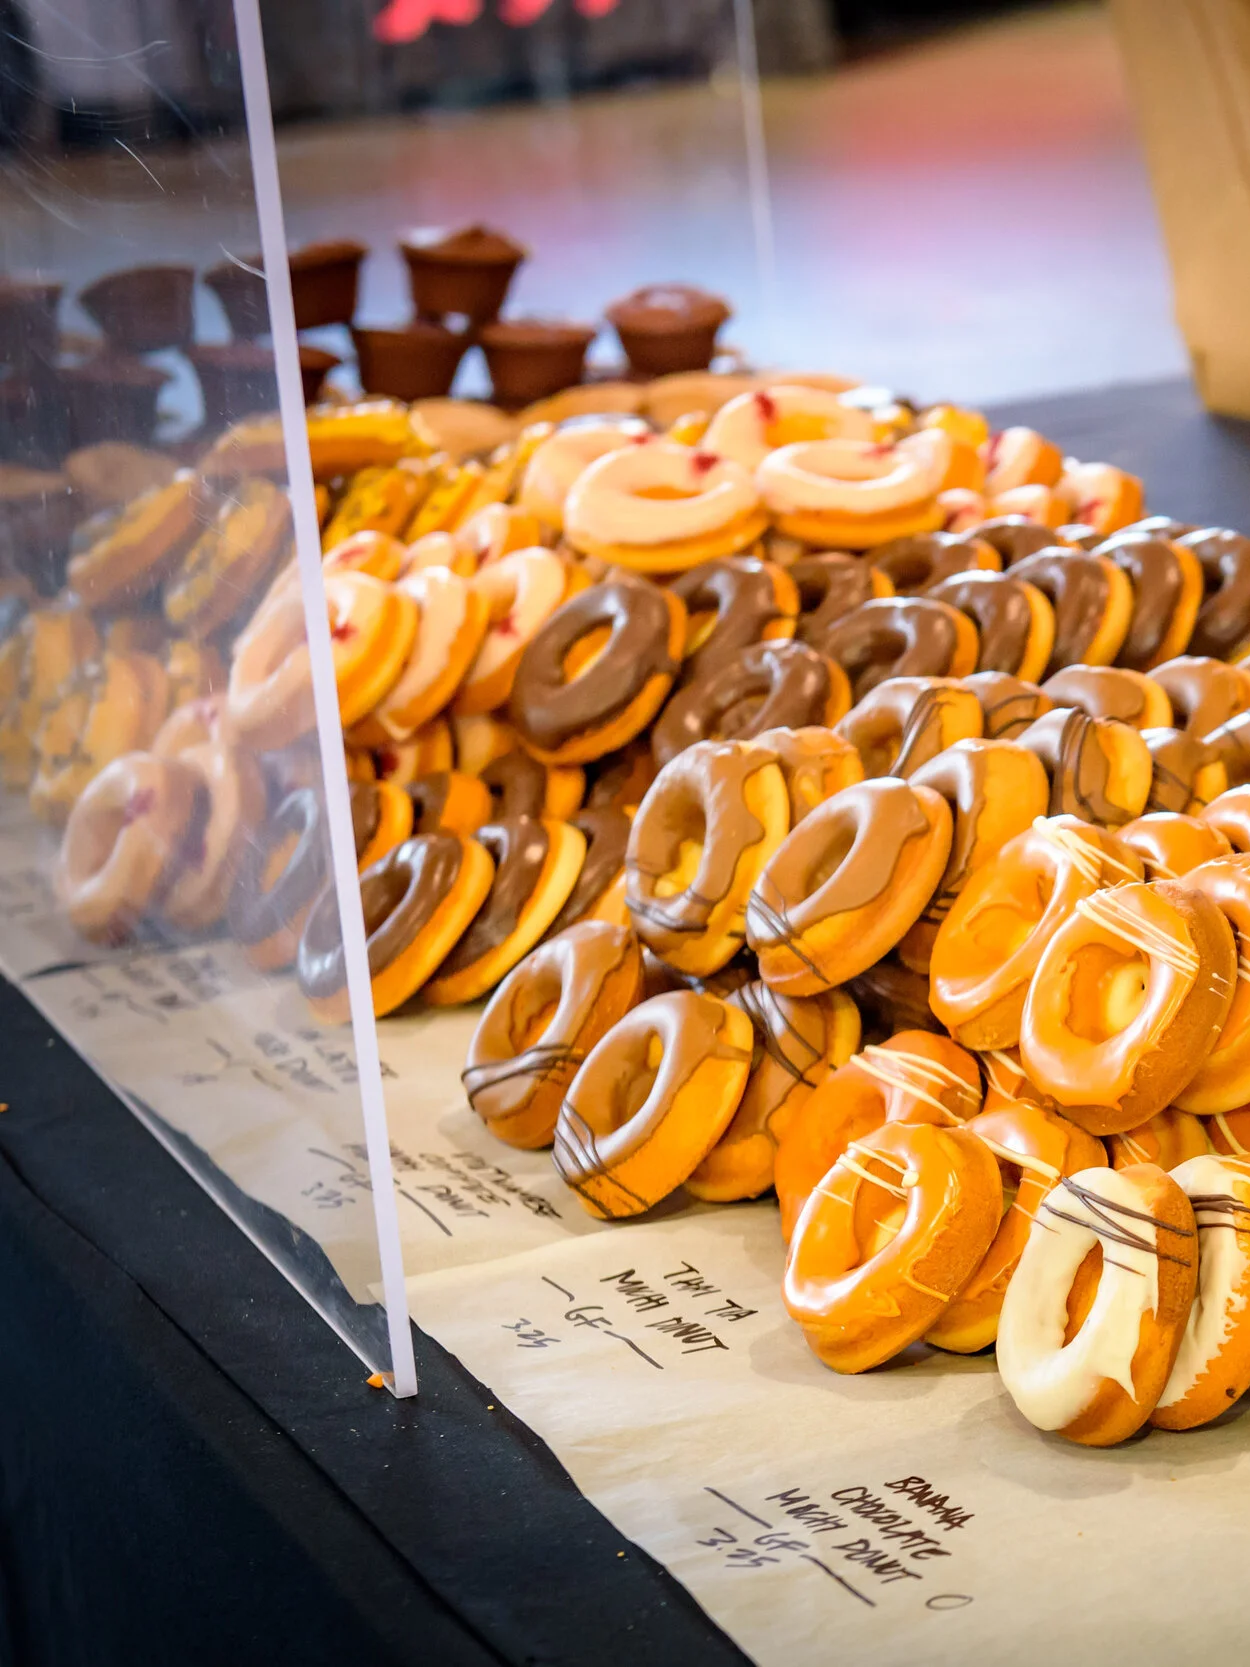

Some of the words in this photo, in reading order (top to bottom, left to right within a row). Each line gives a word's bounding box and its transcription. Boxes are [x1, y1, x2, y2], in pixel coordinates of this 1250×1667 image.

[765, 1488, 848, 1534] MOCHI
[831, 1539, 923, 1585] DONUT
[831, 1486, 952, 1560] CHOCOLATE
[884, 1476, 975, 1531] BANANA
